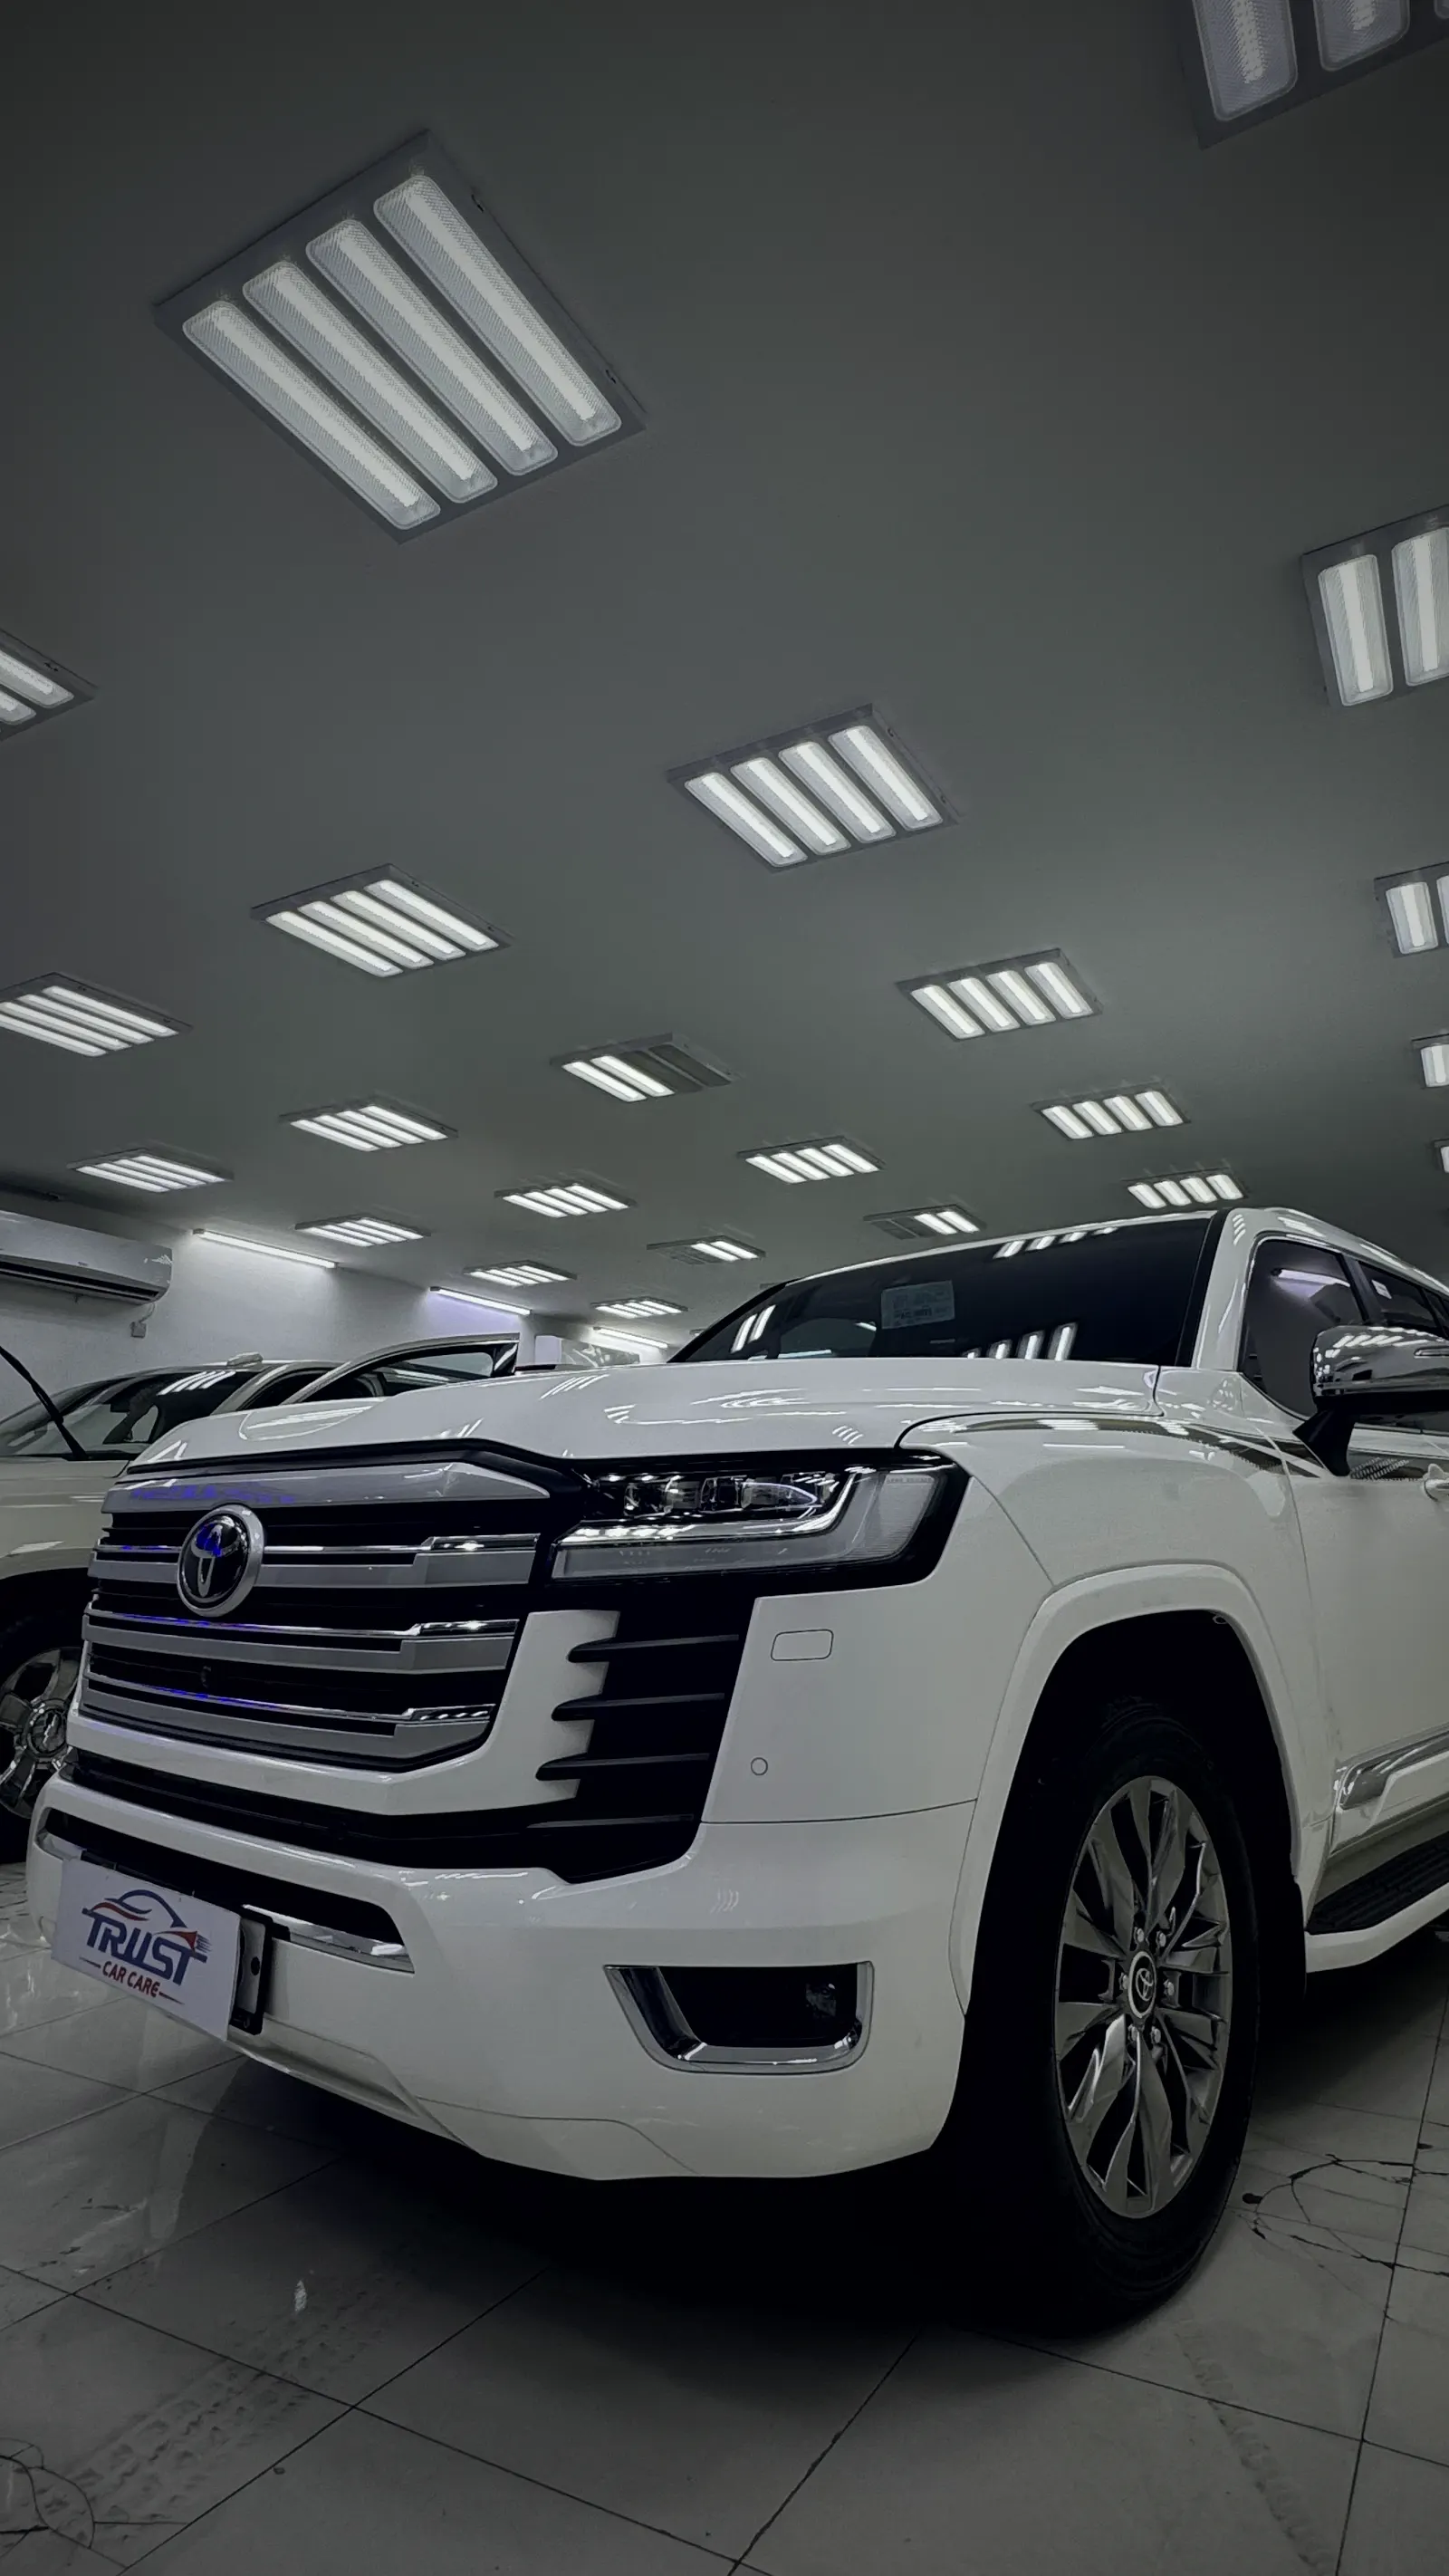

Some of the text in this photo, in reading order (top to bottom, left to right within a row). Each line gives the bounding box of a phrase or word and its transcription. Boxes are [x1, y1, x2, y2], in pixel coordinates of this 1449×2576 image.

[82, 1908, 207, 1986] TRUST
[102, 1960, 160, 1998] CAR CARE
